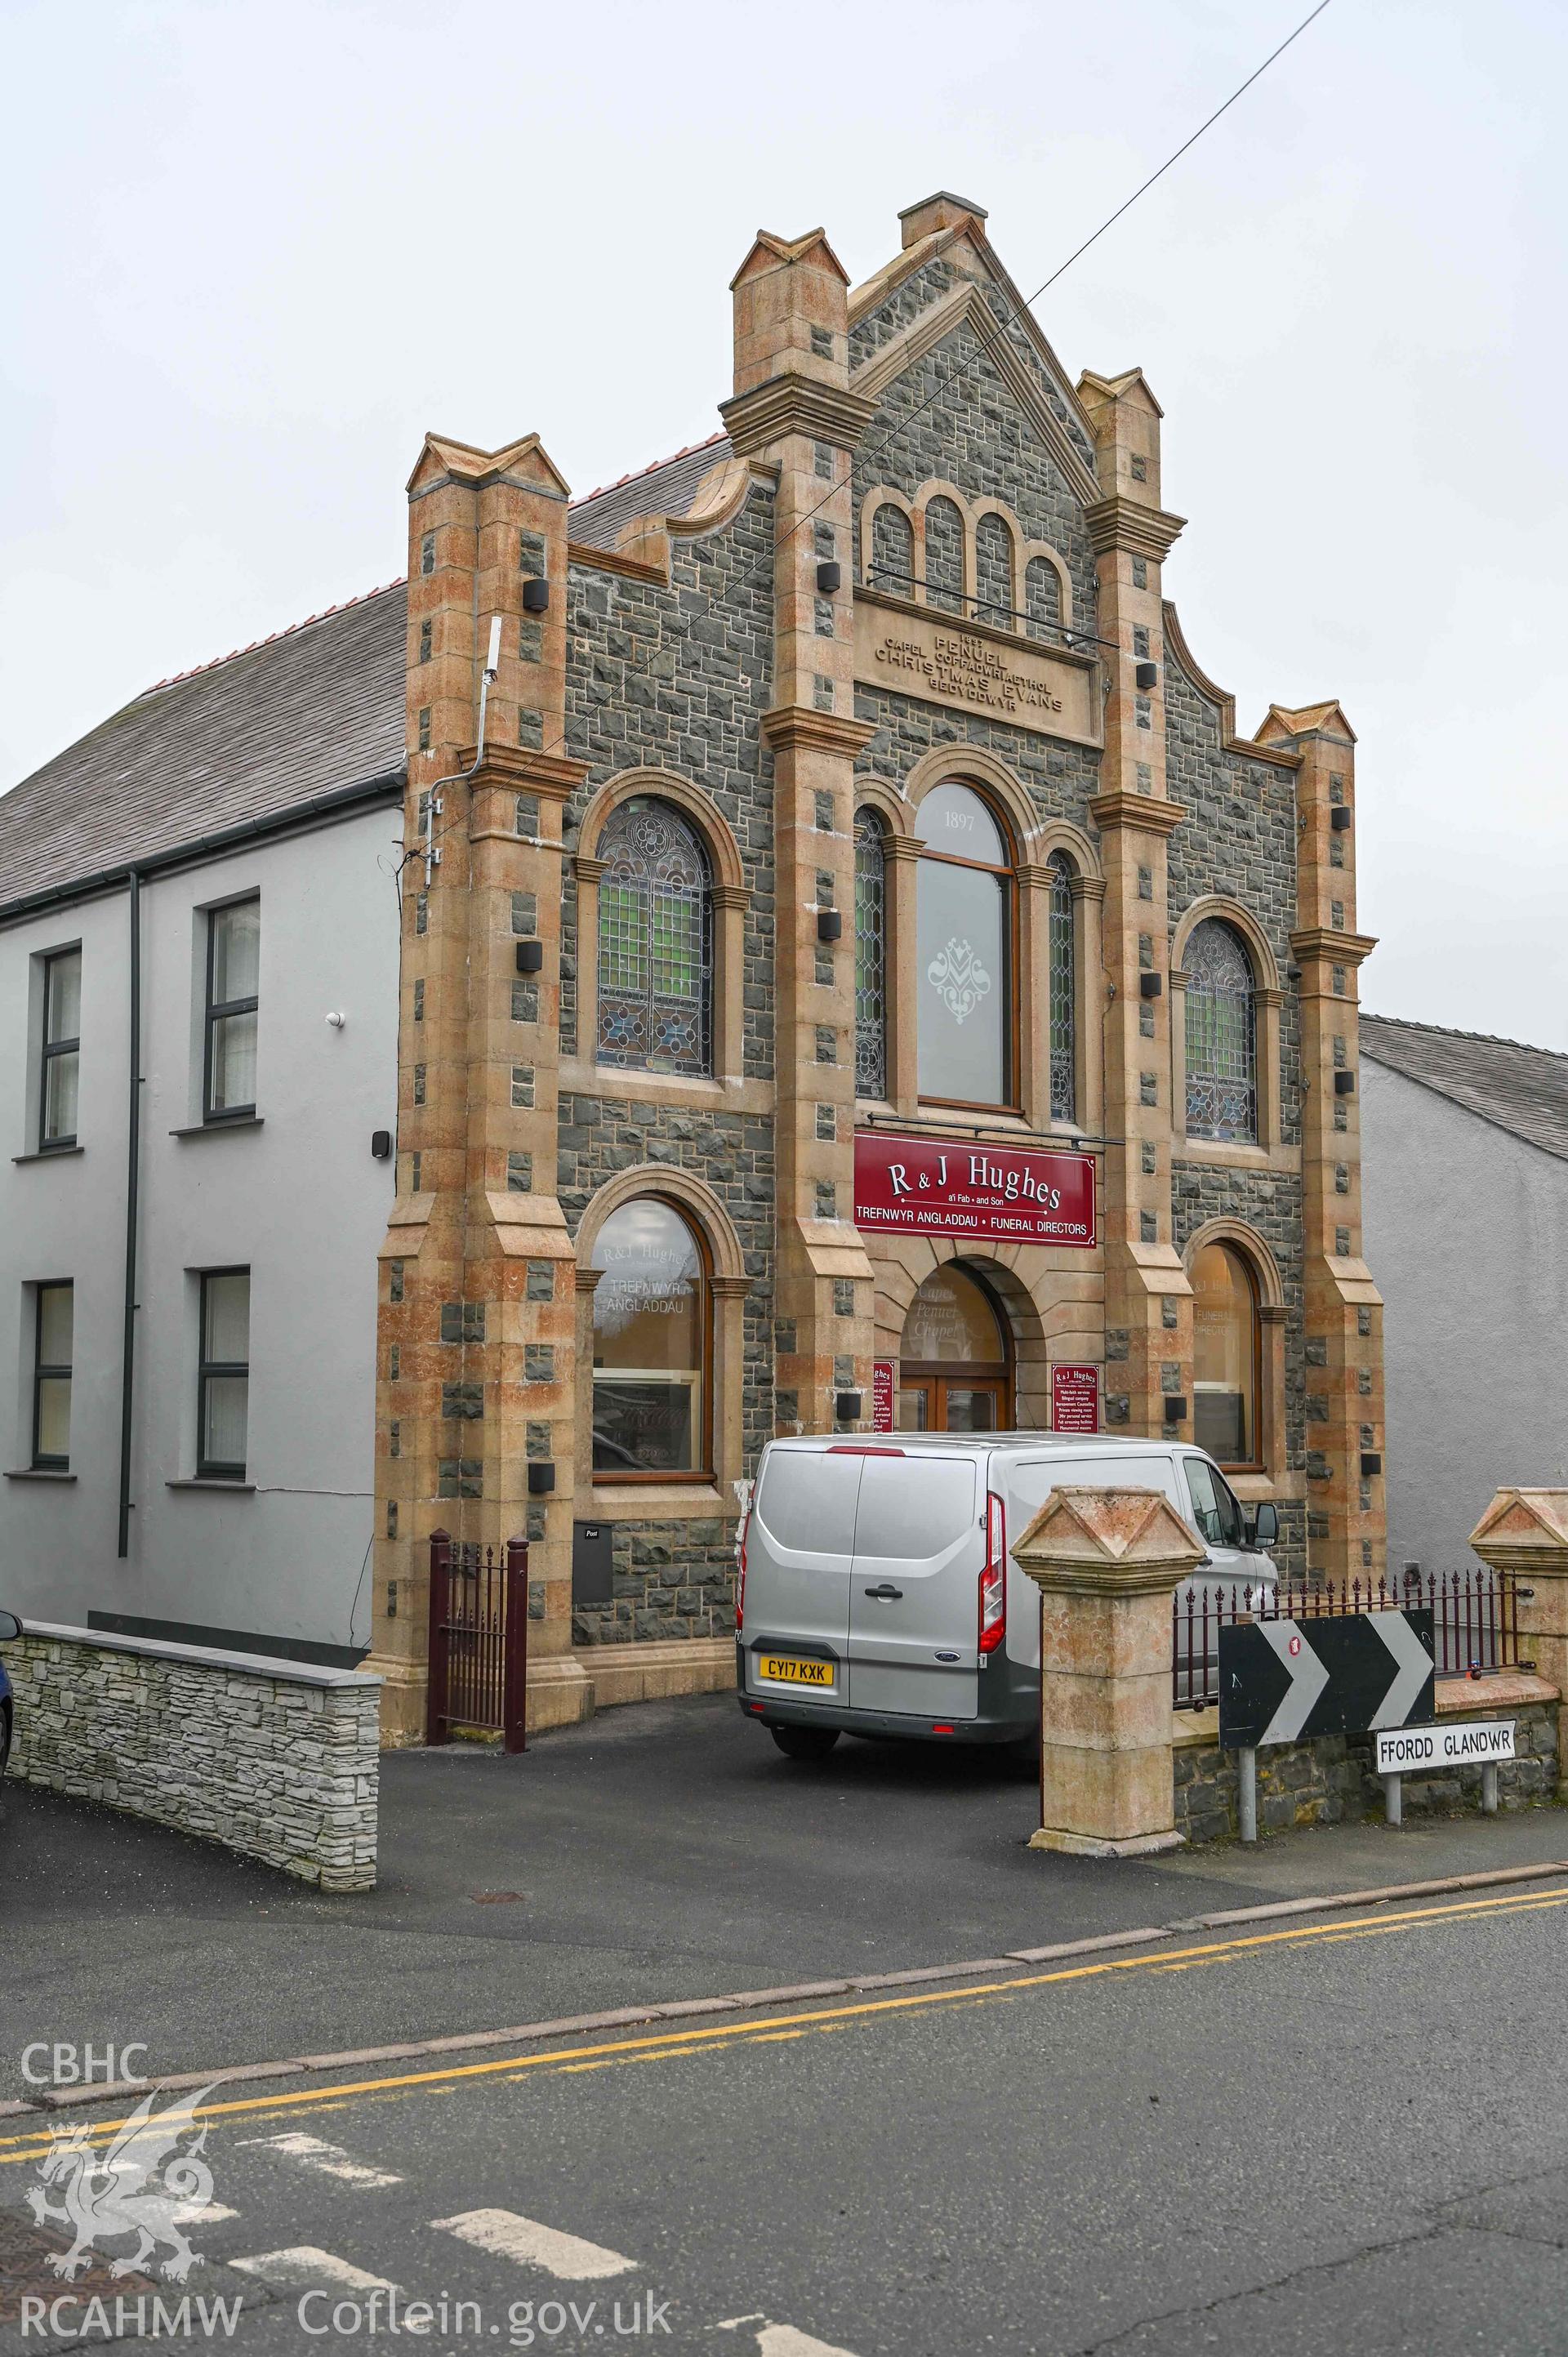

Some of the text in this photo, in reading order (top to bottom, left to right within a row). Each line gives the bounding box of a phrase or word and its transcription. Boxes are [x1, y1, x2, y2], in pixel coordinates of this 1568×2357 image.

[960, 634, 983, 648] 1897
[935, 635, 1008, 670] PENUEL
[885, 637, 1052, 694] CAPEL COFFADWRIAETHOL
[875, 648, 1063, 712] CHRISTMAS EVANS
[929, 678, 1016, 712] BEDYDDWYR
[945, 809, 974, 831] 1897
[888, 1155, 1061, 1210] R & J Hughes
[957, 1194, 970, 1204] Fab
[976, 1196, 990, 1205] and
[991, 1196, 1004, 1206] Son
[856, 1206, 1087, 1235] TREFNWYR ANGLADDAU FUNERAL DIRECTORS
[642, 1244, 688, 1268] Hughes
[611, 1279, 680, 1295] TREFNWYR
[919, 1284, 956, 1302] Capel
[607, 1299, 684, 1314] ANGLADDAU
[916, 1302, 956, 1319] Penuel
[915, 1321, 957, 1341] Chapel
[1073, 1371, 1096, 1383] Hughes
[768, 1660, 825, 1681] CY17 KXK
[1380, 1730, 1511, 1762] FFORDD GLANDWR
